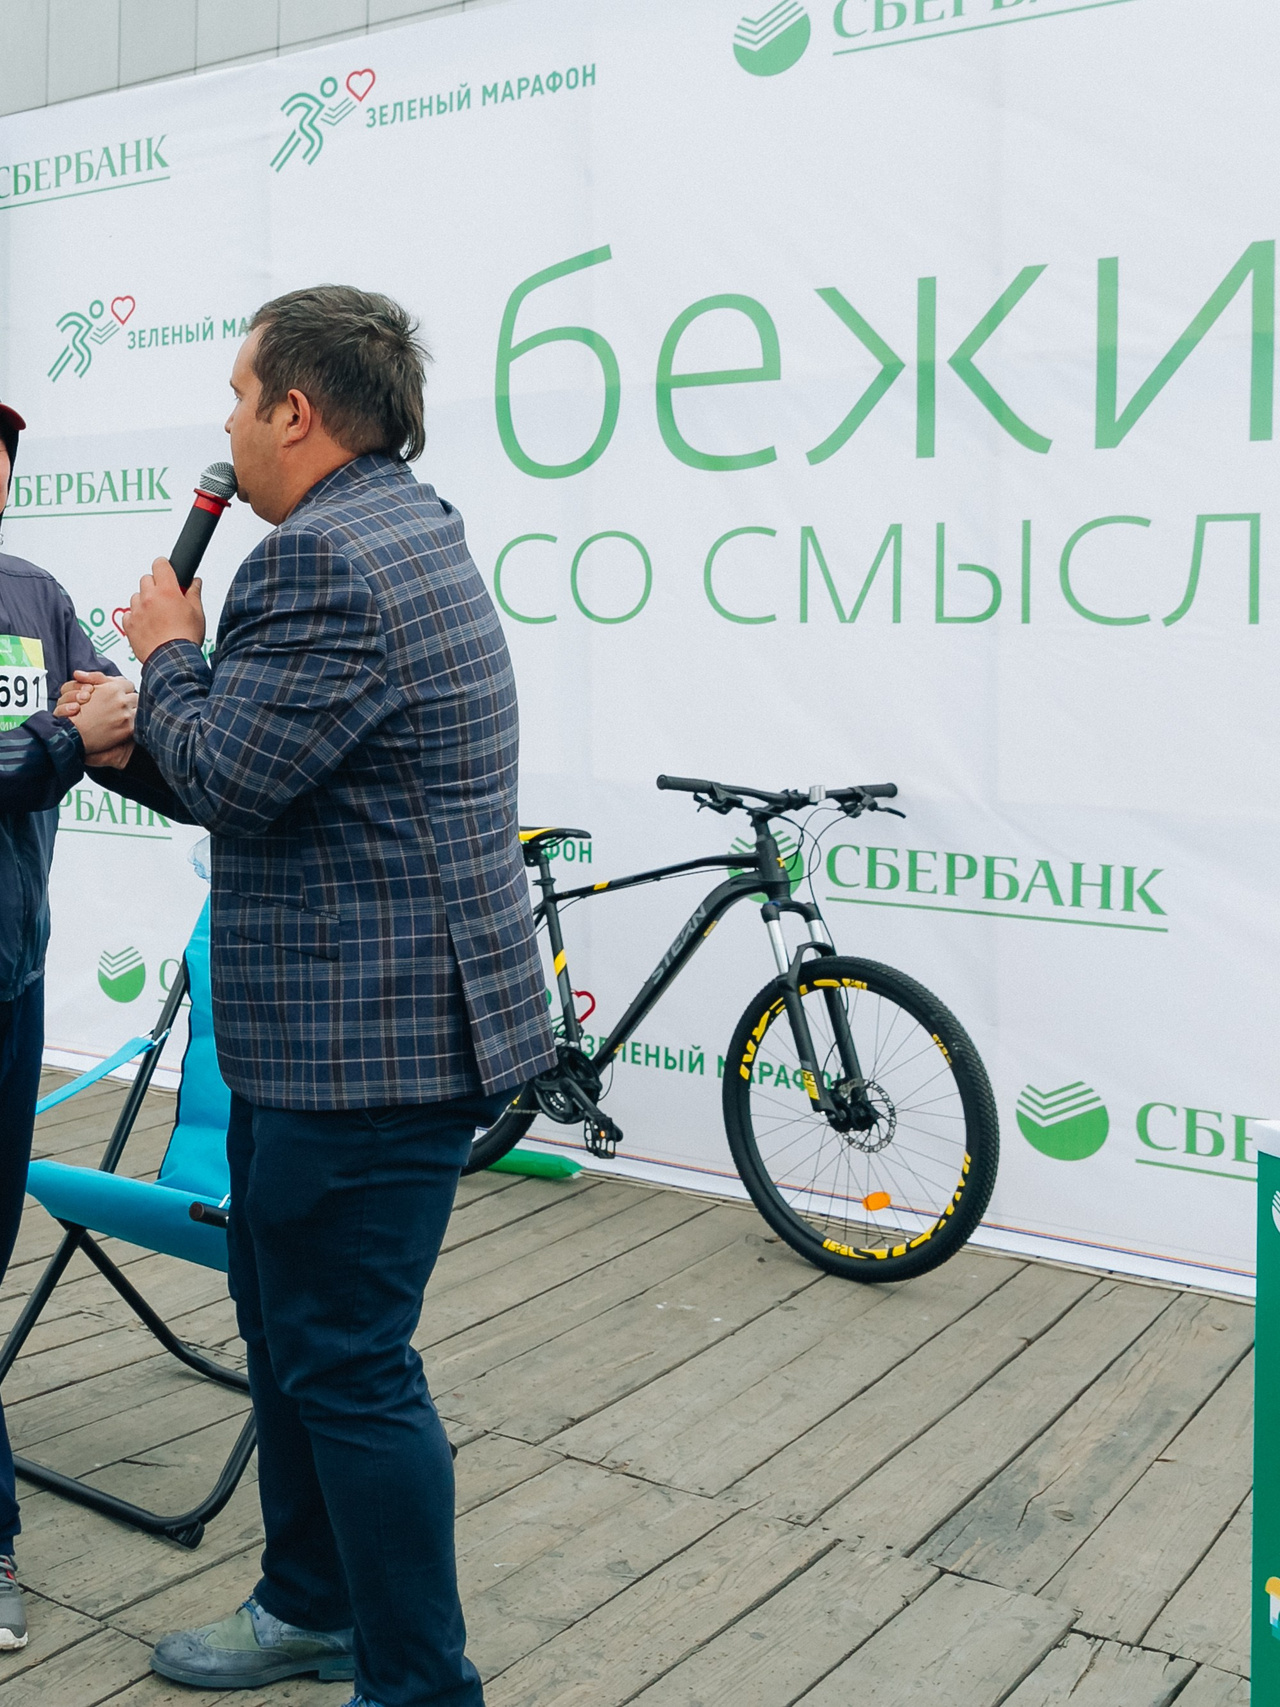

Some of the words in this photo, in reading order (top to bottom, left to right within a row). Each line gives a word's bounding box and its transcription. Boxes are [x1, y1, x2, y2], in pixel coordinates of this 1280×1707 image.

[365, 83, 471, 128] ЗЕЛЕНЫЙ
[481, 63, 597, 106] МАРАФОН
[127, 316, 214, 350] ЗЕЛЕНЫЙ
[5, 466, 172, 508] БЕРБАНК
[826, 844, 1168, 916] СБЕРБАНК
[583, 1034, 705, 1076] ЗЕНЫЙ
